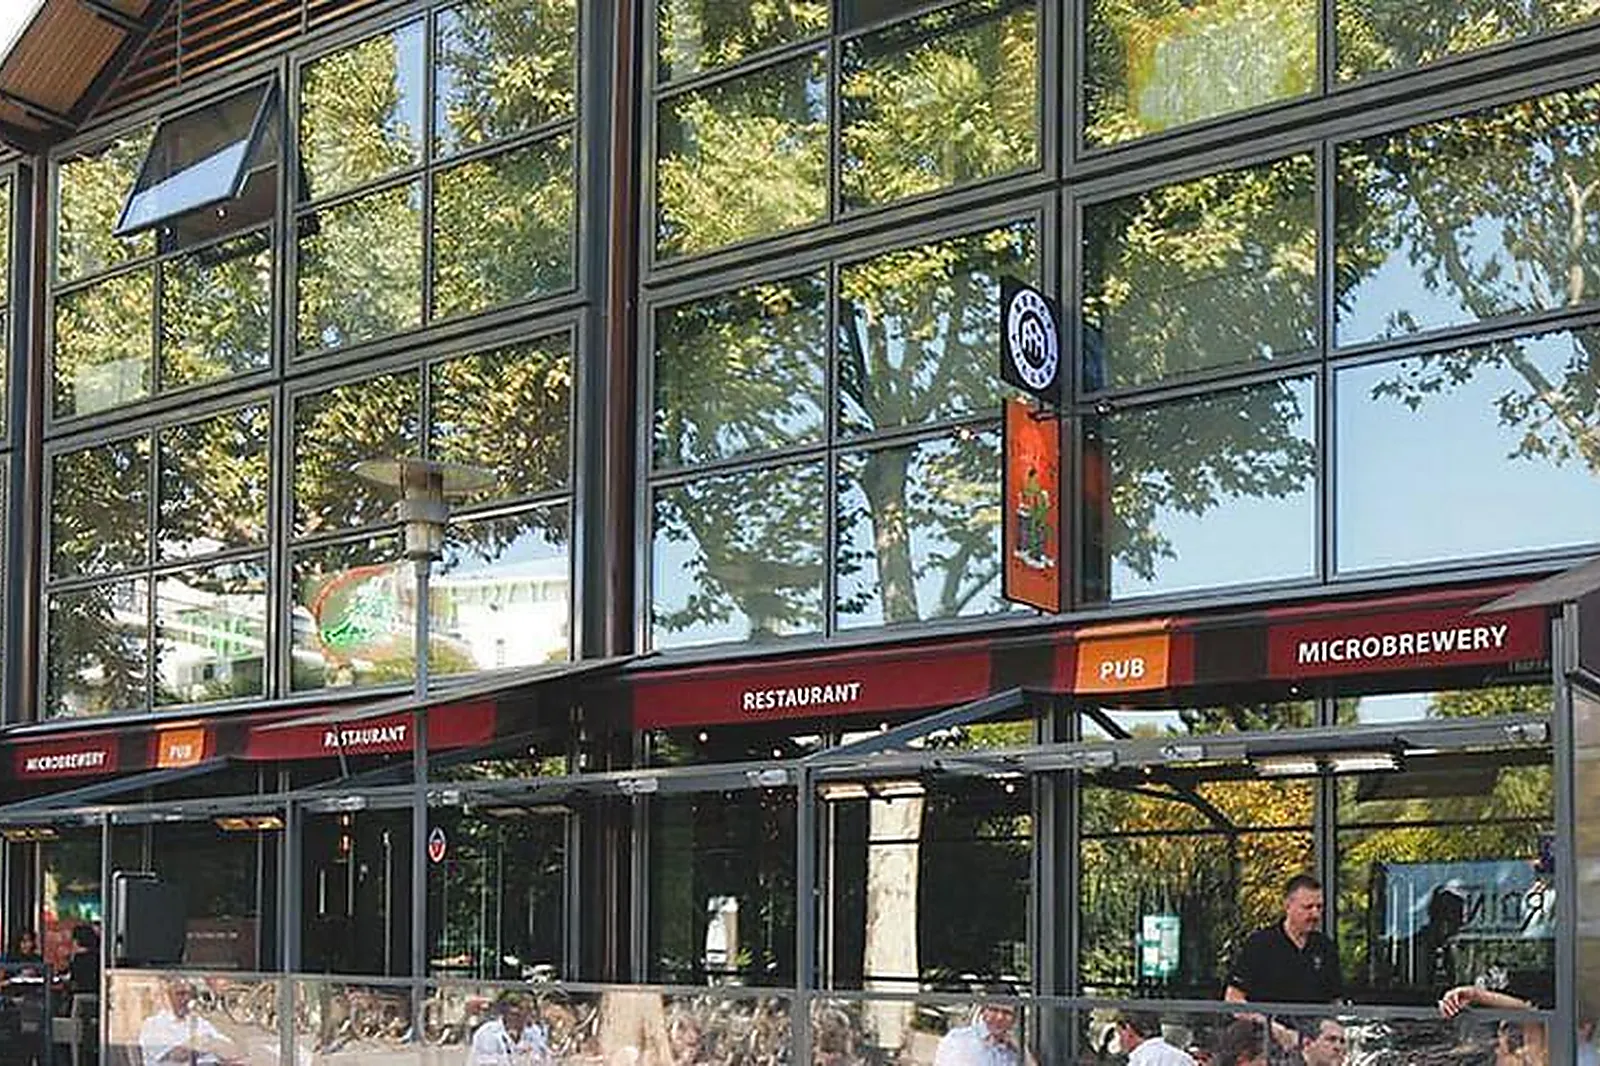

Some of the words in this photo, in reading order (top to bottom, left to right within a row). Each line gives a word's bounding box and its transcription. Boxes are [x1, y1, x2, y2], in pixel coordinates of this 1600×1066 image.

[1298, 625, 1508, 663] MICROBREWERY
[1099, 657, 1145, 680] PUB
[743, 682, 860, 710] RESTAURANT
[169, 745, 192, 759] PUB
